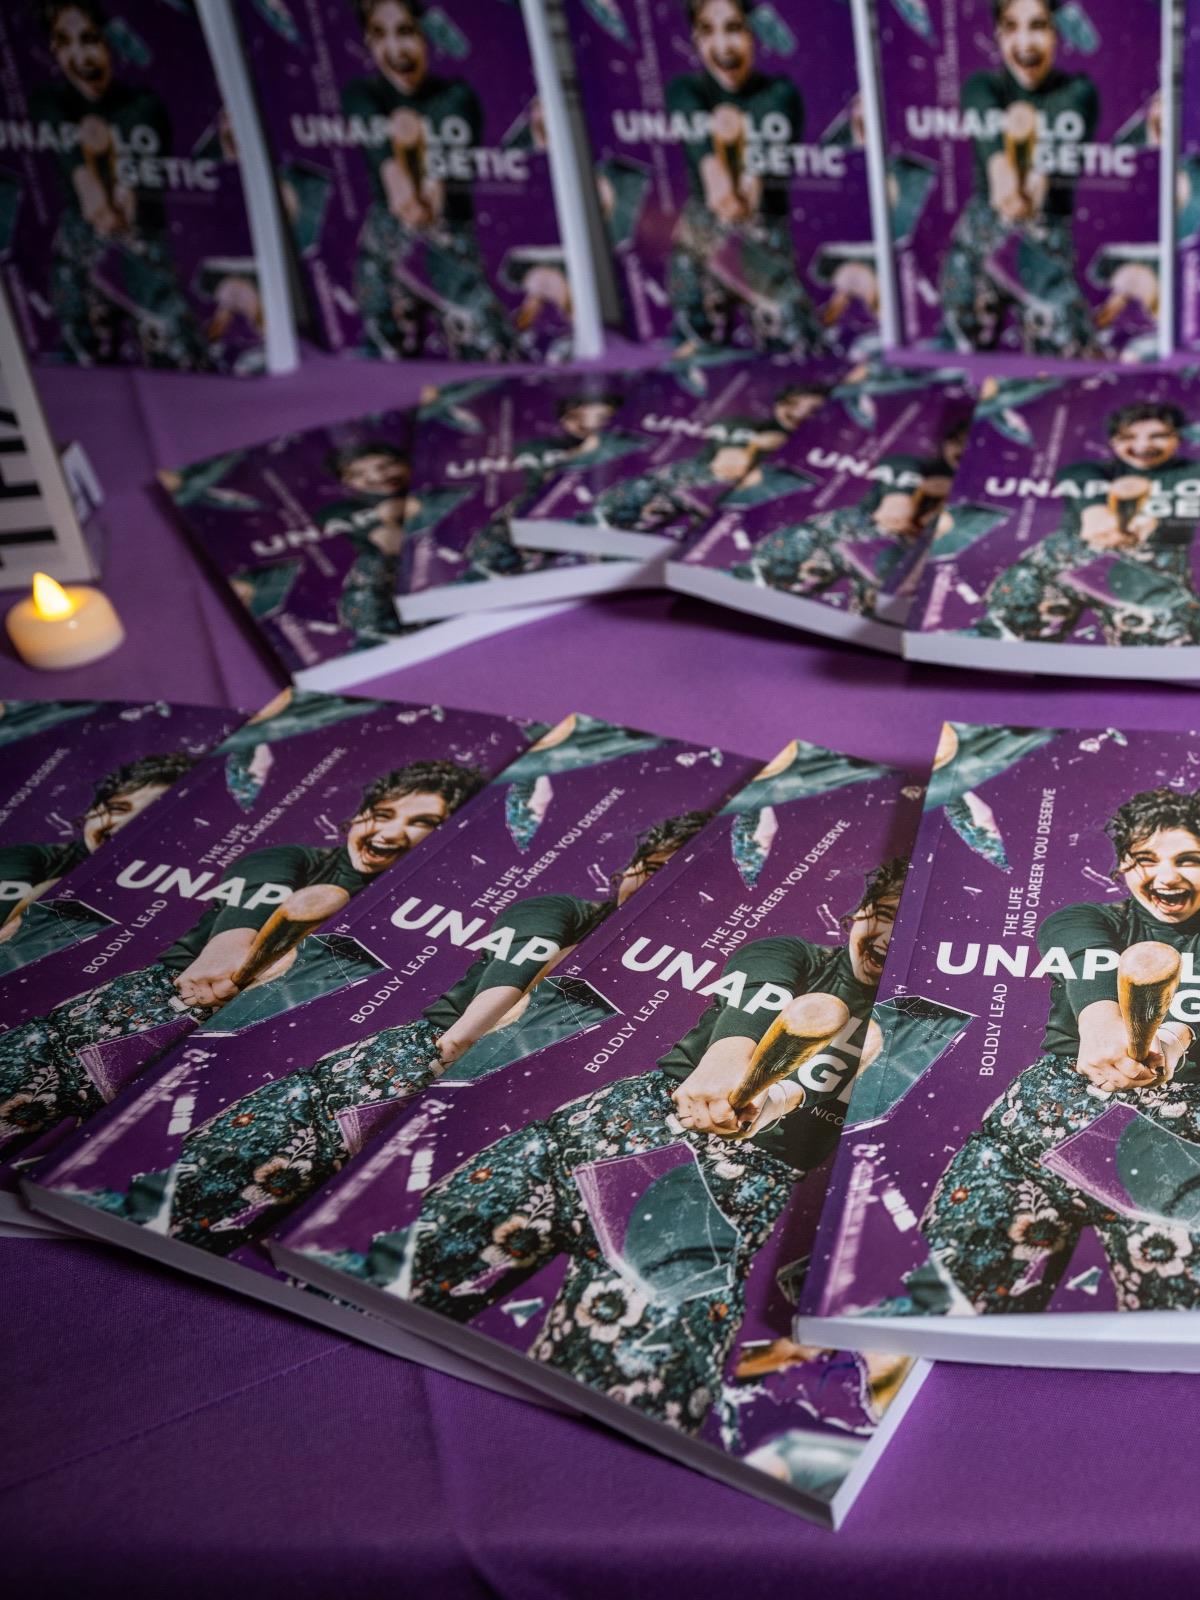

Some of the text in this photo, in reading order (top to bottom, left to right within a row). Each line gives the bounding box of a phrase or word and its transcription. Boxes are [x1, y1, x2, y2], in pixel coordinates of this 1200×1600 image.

[116, 157, 220, 191] GETIC
[429, 148, 530, 182] GETIC
[744, 143, 846, 177] GETIC
[1033, 143, 1136, 177] GETIC
[198, 822, 250, 866] THE LIFE
[219, 843, 245, 868] AND
[240, 804, 286, 849] CAREER
[489, 786, 626, 914] AND CAREER YOU DESERVE
[1020, 787, 1057, 938] AND CAREER YOU DESERVE
[471, 864, 525, 910] THE LIFE
[719, 819, 851, 957] AND CAREER YOU DESERVE
[1003, 886, 1024, 937] THE LIFE
[82, 898, 169, 975] BOLDLY LEAD
[701, 903, 752, 951] THE LIFE
[350, 944, 438, 1024] BOLDLY LEAD
[584, 989, 670, 1074] BOLDLY LEAD
[979, 983, 1008, 1076] BOLDLY LEAD
